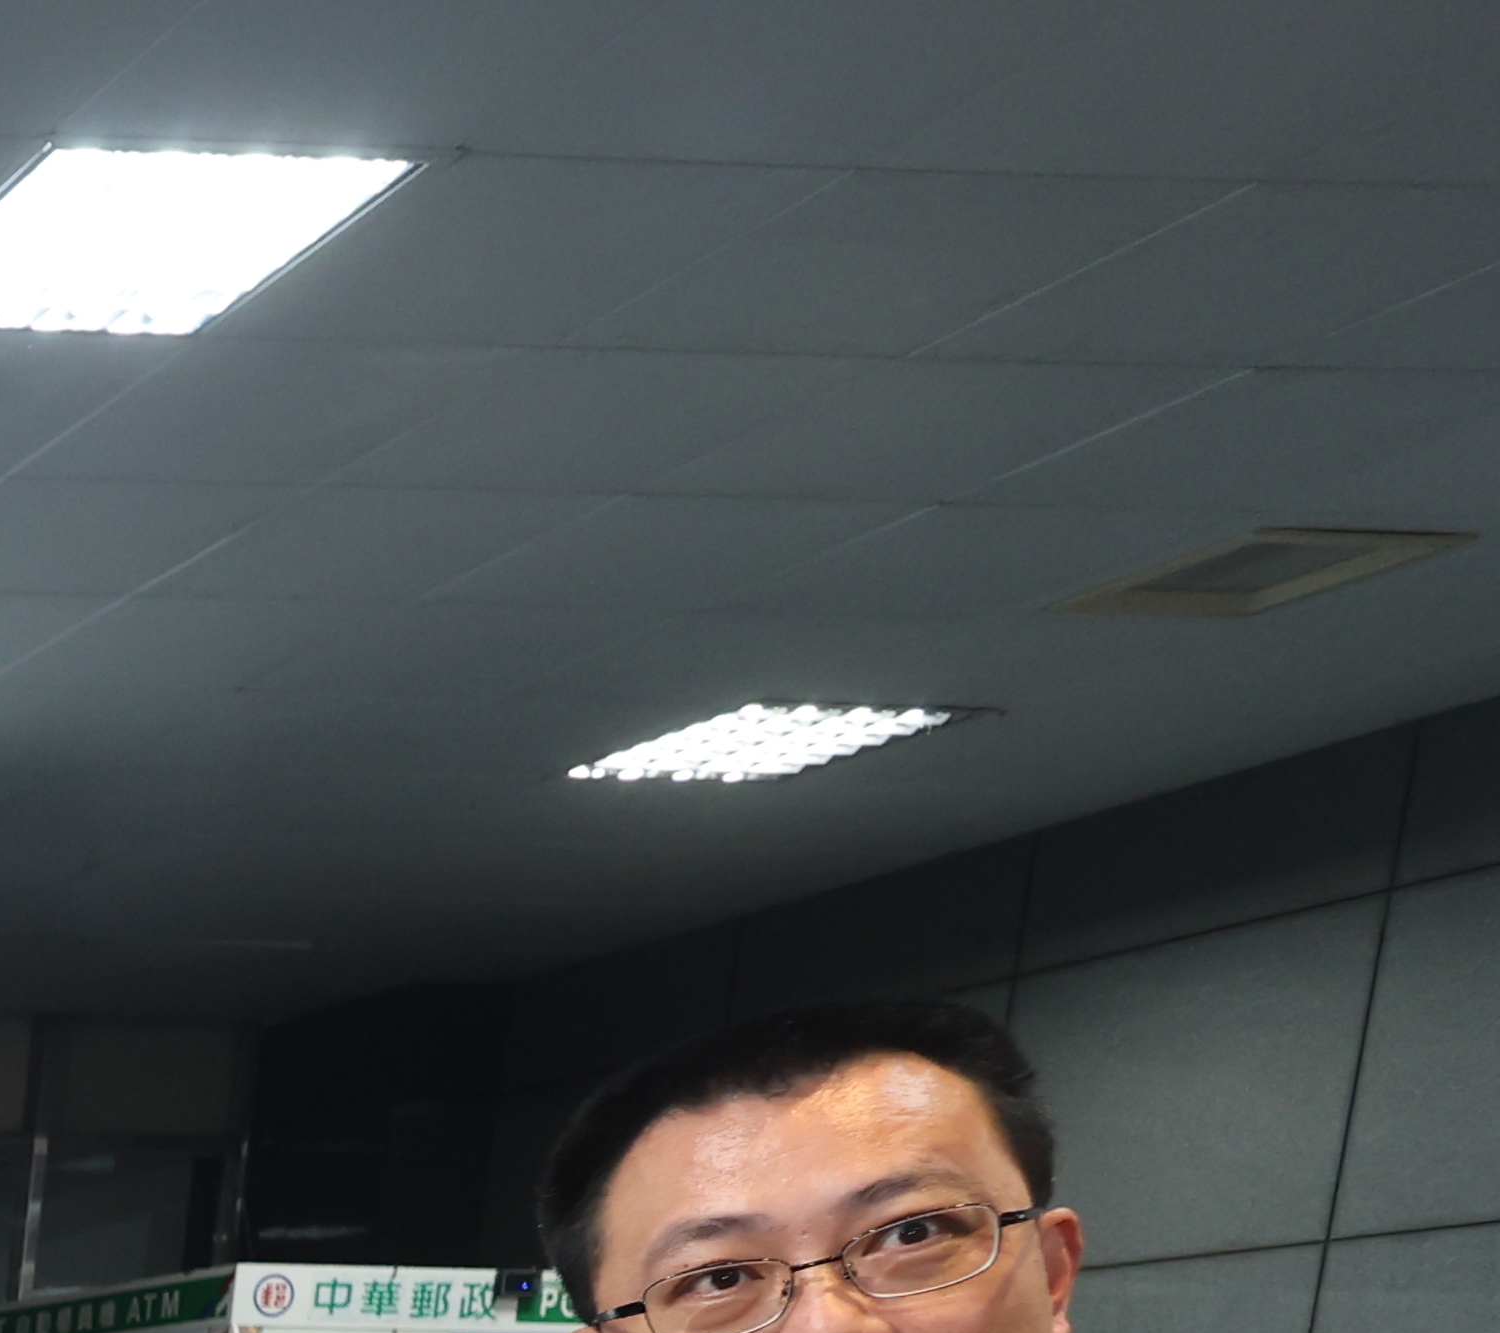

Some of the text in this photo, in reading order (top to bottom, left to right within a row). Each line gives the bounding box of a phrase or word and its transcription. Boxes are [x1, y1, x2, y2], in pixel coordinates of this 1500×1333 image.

[125, 1289, 181, 1325] ATM
[313, 1278, 499, 1321] 中華郵政
